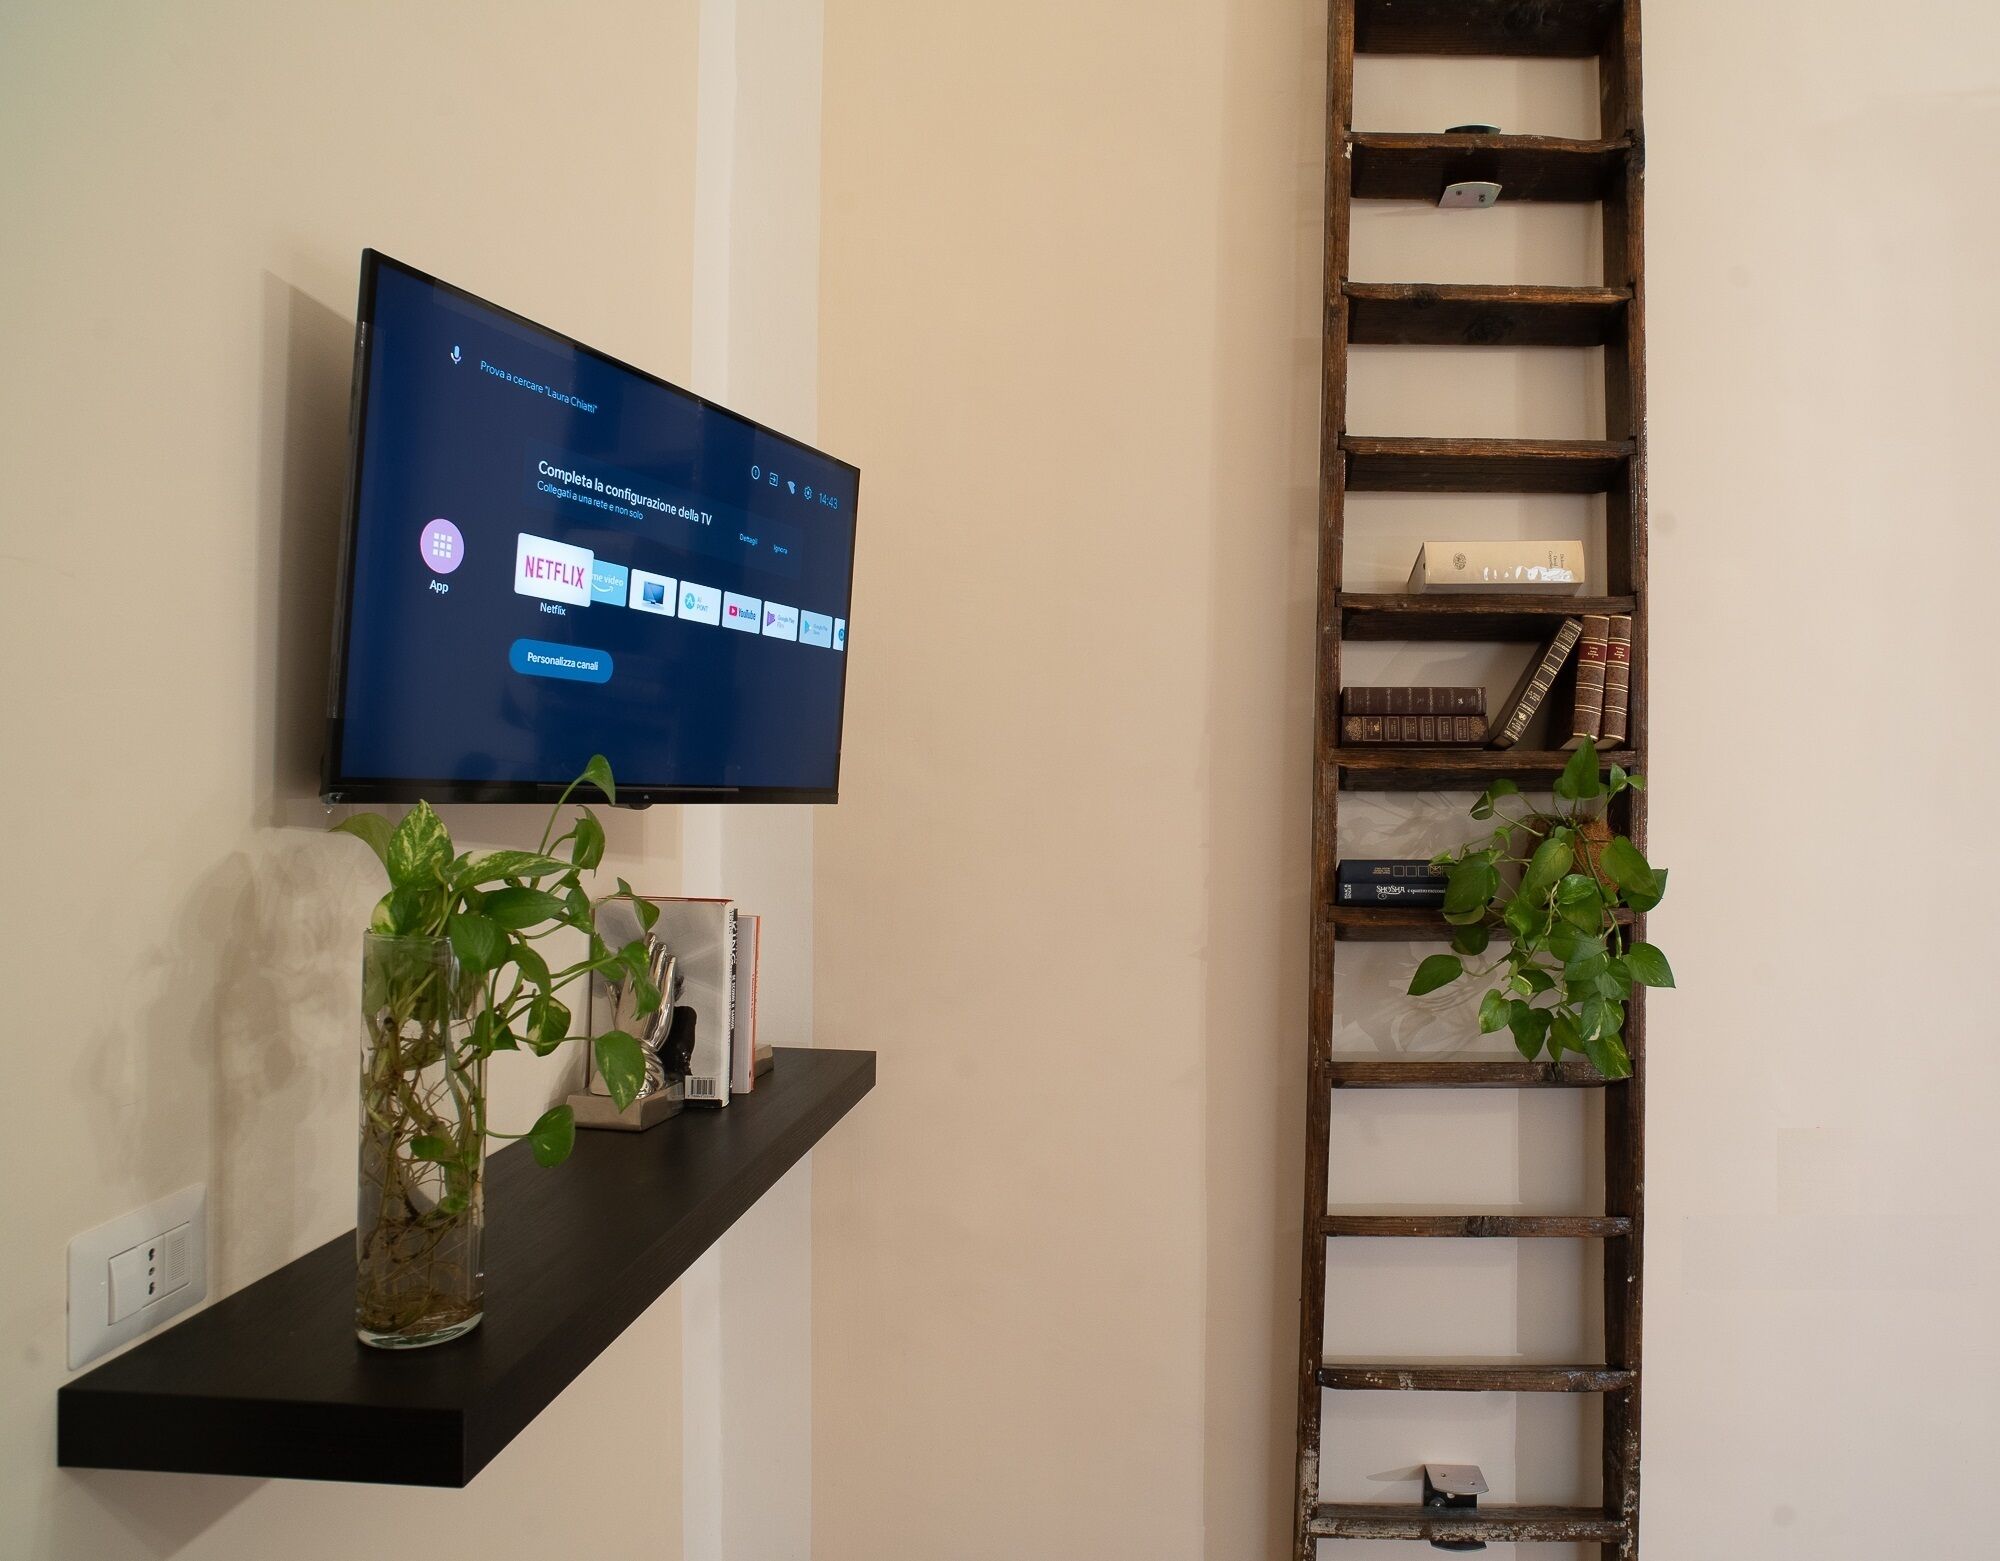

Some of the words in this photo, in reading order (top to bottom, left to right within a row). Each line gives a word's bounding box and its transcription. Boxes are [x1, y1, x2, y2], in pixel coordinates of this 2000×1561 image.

[480, 360, 504, 379] Prova
[506, 372, 512, 382] a
[512, 375, 544, 394] cercare
[537, 480, 572, 498] Collegati
[572, 492, 578, 500] a
[578, 494, 592, 505] una
[593, 498, 608, 510] rete
[614, 505, 628, 516] non
[628, 508, 644, 520] solo
[538, 460, 593, 488] Completa
[594, 478, 604, 492] la
[605, 484, 677, 514] configurazione
[678, 506, 699, 522] della
[700, 512, 712, 526] TV
[524, 555, 584, 590] NETFLIX
[604, 576, 624, 587] video
[429, 580, 449, 594] App
[540, 602, 566, 616] Netflix
[527, 651, 576, 668] Personalizza
[576, 660, 599, 671] canali
